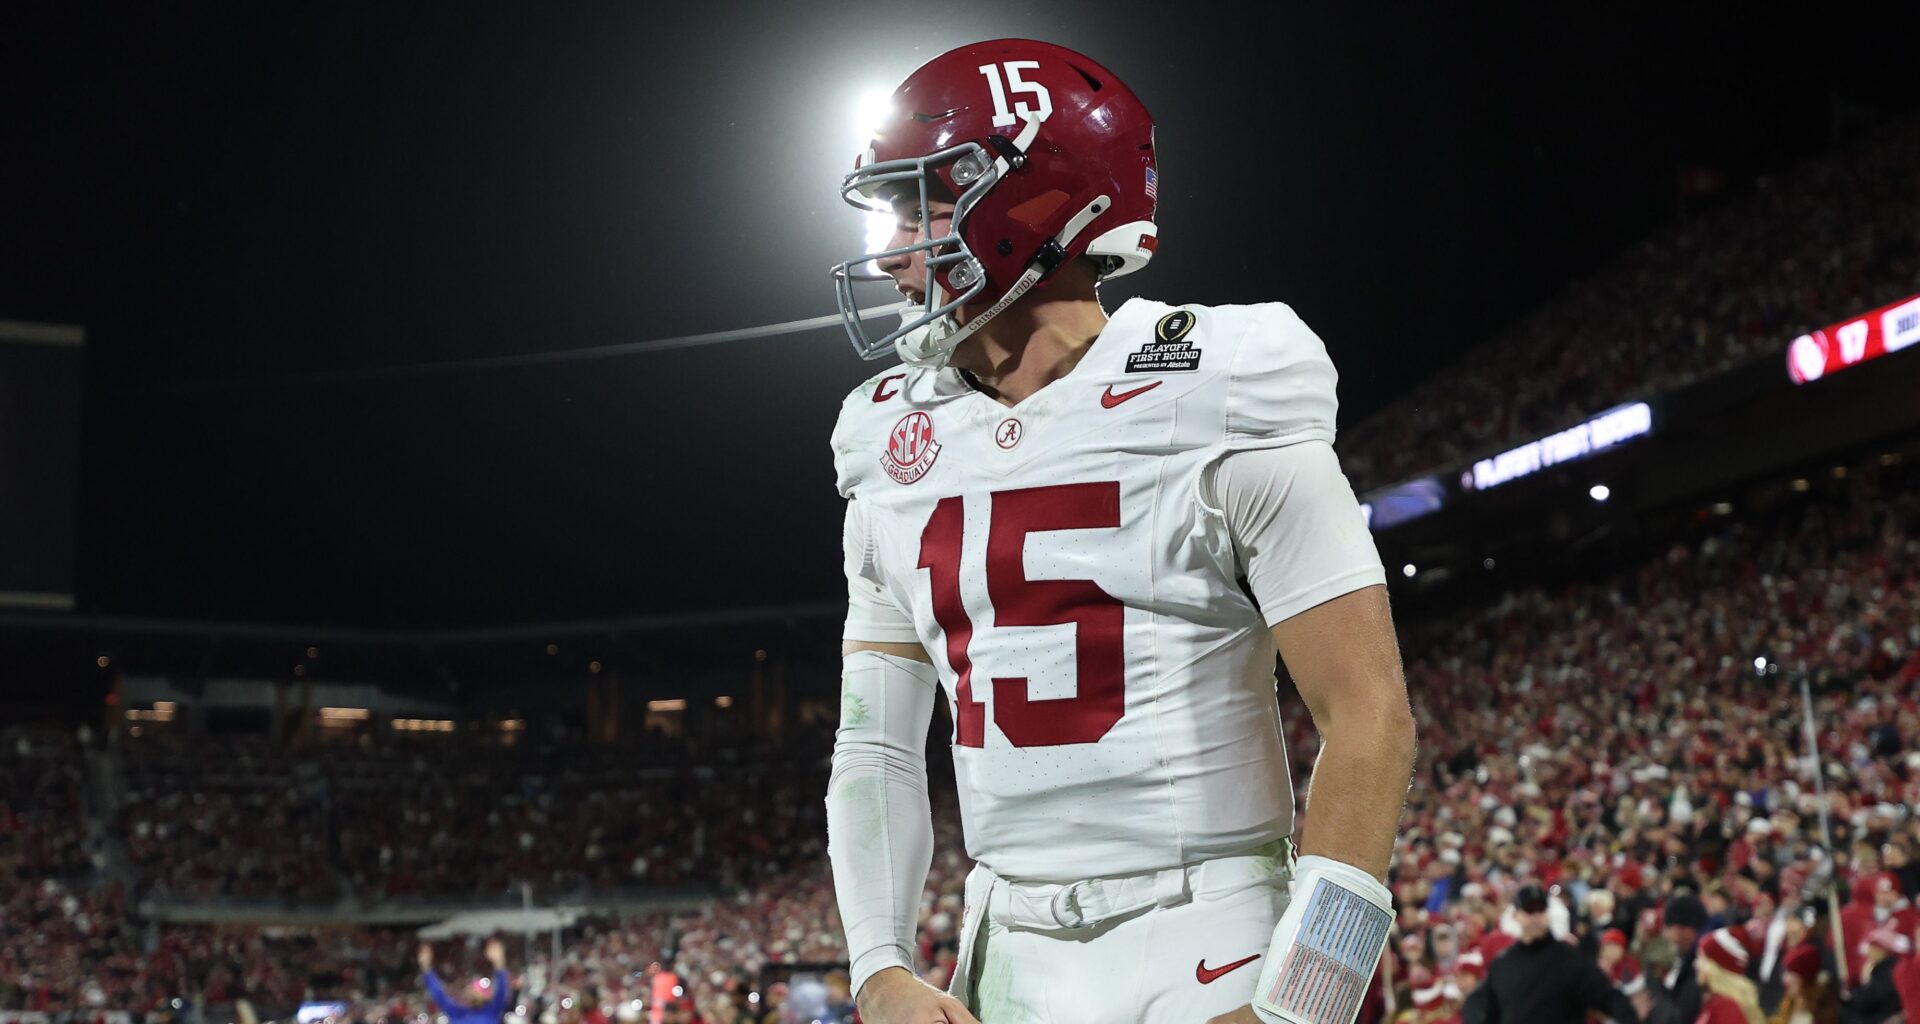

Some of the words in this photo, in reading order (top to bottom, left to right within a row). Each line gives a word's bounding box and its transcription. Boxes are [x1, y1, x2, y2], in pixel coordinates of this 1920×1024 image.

[979, 61, 1053, 128] 15
[968, 296, 1014, 331] CRIMSON
[1012, 273, 1036, 296] TIDE
[1129, 353, 1161, 363] FIRST
[1162, 351, 1199, 361] ROUND
[1143, 343, 1190, 353] PLAYOFF
[872, 373, 906, 403] C
[892, 414, 931, 464] SEC
[888, 455, 931, 483] GRADUATE
[916, 481, 1125, 748] 15
